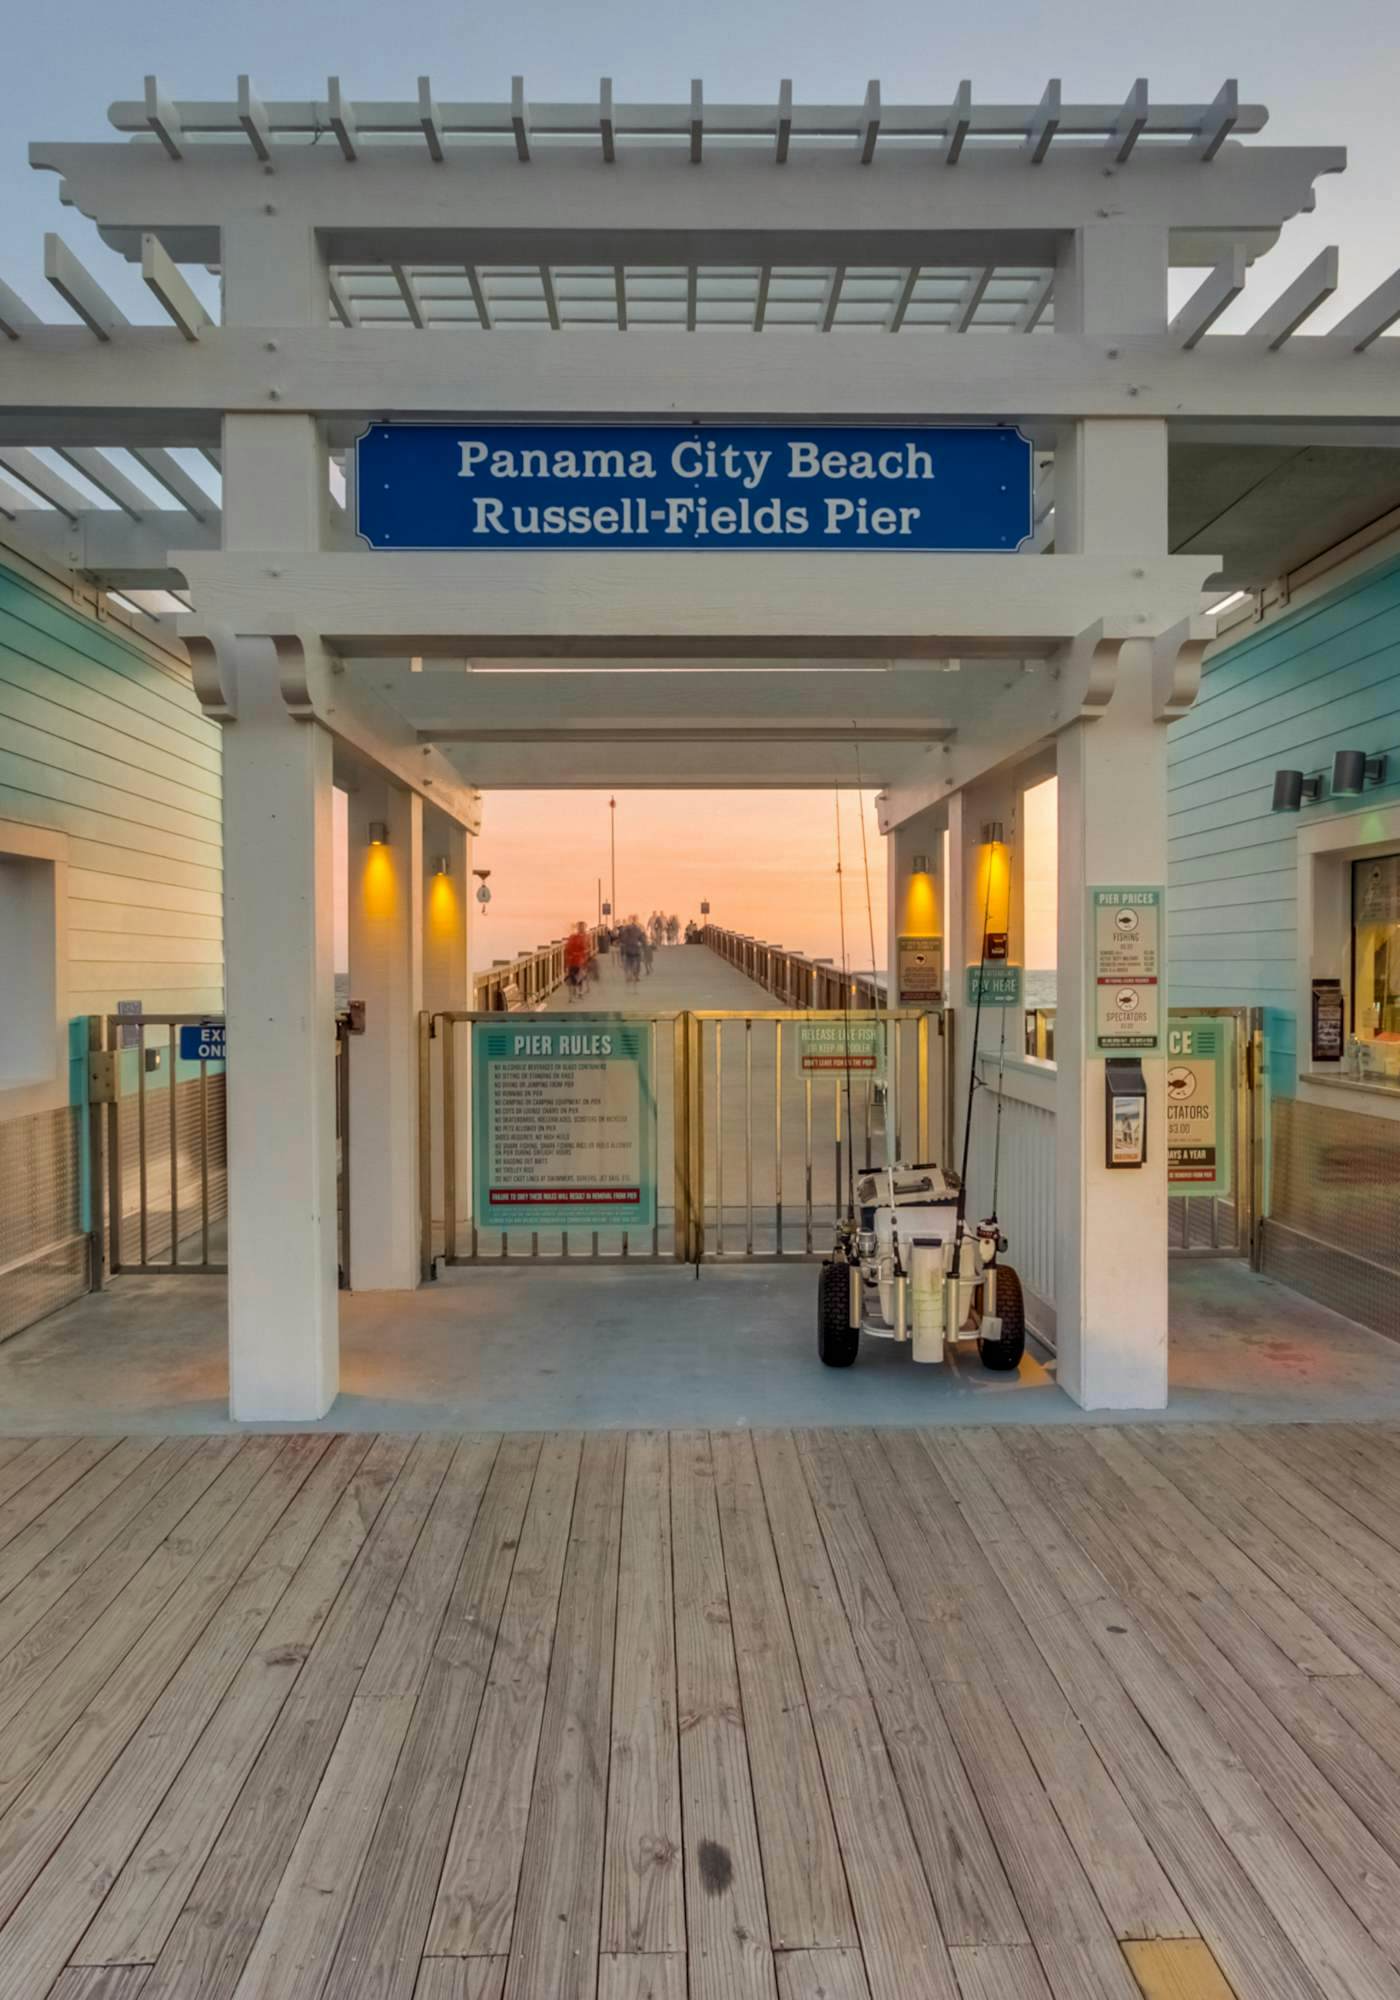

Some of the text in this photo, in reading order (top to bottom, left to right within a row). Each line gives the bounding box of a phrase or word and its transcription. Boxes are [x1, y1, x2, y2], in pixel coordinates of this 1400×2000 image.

[457, 441, 934, 488] Panama City Beach
[473, 498, 921, 536] Russell-Fields Pier
[1099, 892, 1154, 905] PIER PRICES
[1113, 933, 1139, 942] FISHING
[972, 979, 1017, 993] PY HERE
[1106, 1012, 1147, 1022] SPECTATORS
[801, 1029, 835, 1041] RELEASE
[858, 1029, 877, 1041] FISH
[515, 1035, 612, 1055] PIER RULES
[1169, 1123, 1191, 1134] $3.00
[1183, 1150, 1189, 1159] A
[1189, 1150, 1207, 1159] YEAR
